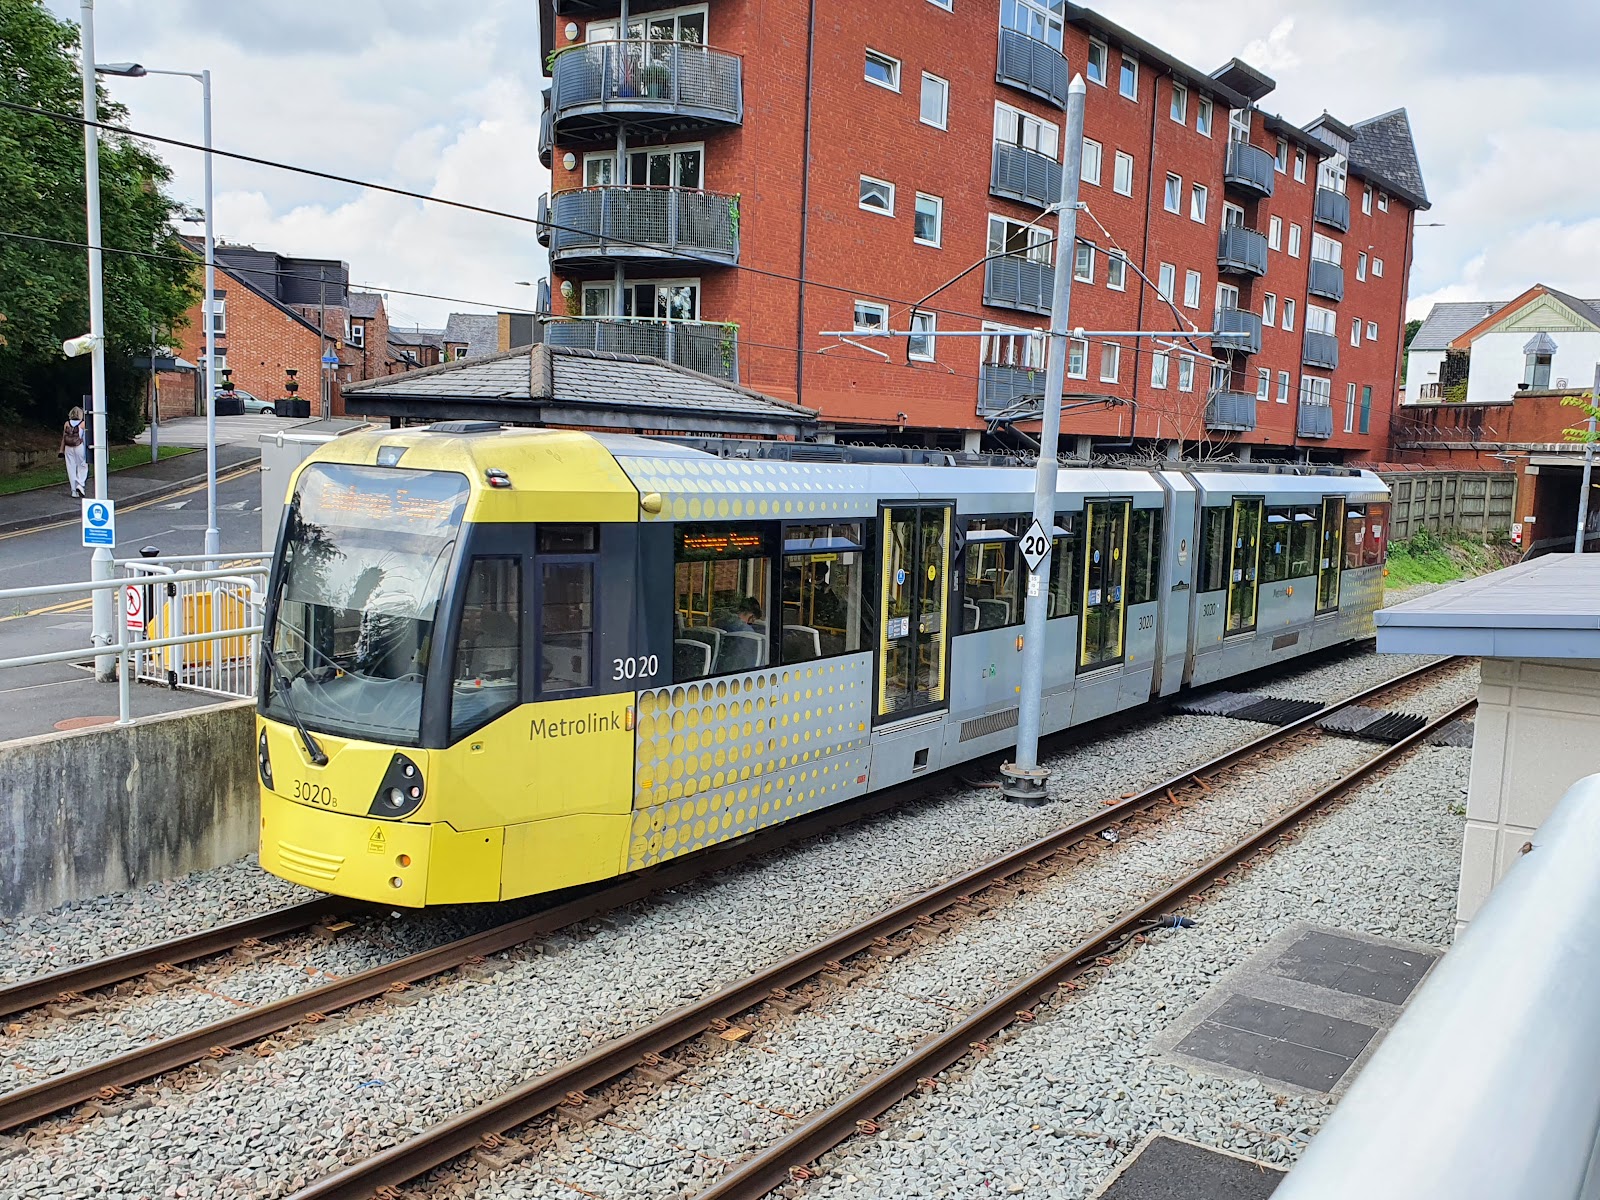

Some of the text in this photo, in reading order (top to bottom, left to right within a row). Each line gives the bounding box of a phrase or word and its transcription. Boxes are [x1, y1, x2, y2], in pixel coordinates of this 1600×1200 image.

[1025, 536, 1045, 556] 20
[1138, 614, 1154, 631] 3020
[612, 654, 659, 681] 3020
[530, 710, 621, 741] Metrolink
